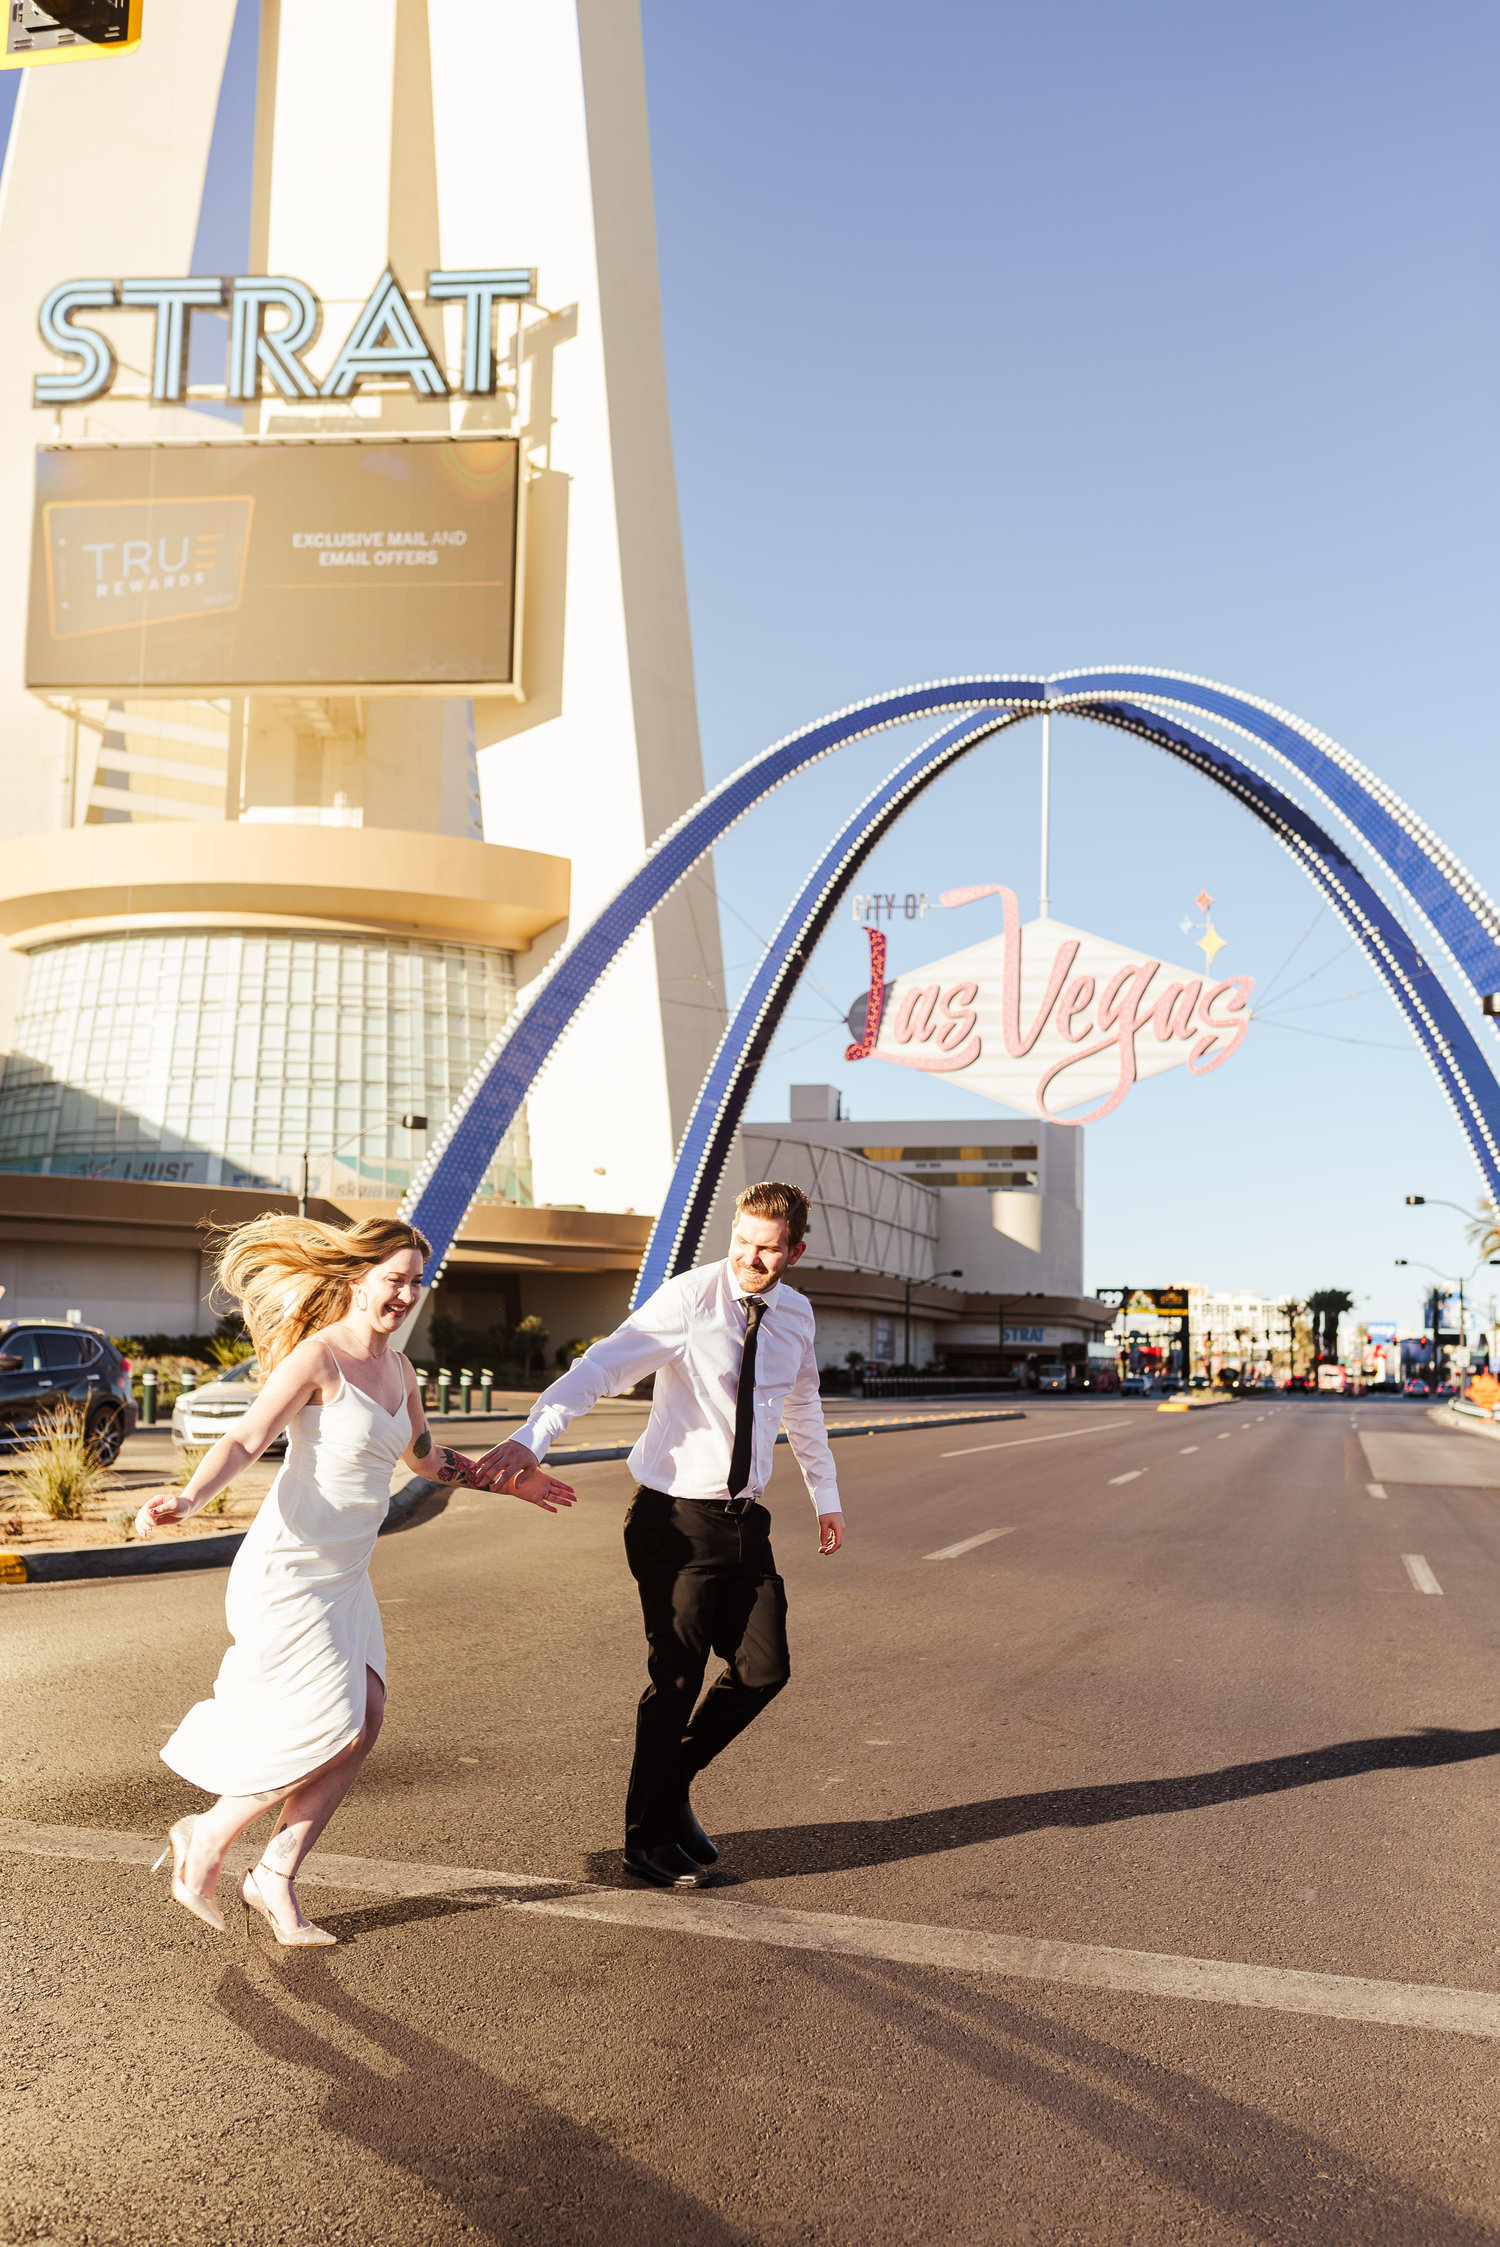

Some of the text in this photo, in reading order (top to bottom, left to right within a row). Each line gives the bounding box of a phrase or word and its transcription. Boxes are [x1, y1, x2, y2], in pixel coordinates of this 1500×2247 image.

[33, 260, 537, 408] STRAT
[292, 530, 468, 548] EXCLUSIVE MAIL AND
[82, 534, 218, 579] TRUE
[319, 549, 439, 567] EMAIL OFFERS
[96, 571, 205, 598] REWARDS
[852, 894, 929, 921] CITY OF
[845, 885, 1255, 1126] Las Vegas
[1002, 1327, 1045, 1342] STRAT
